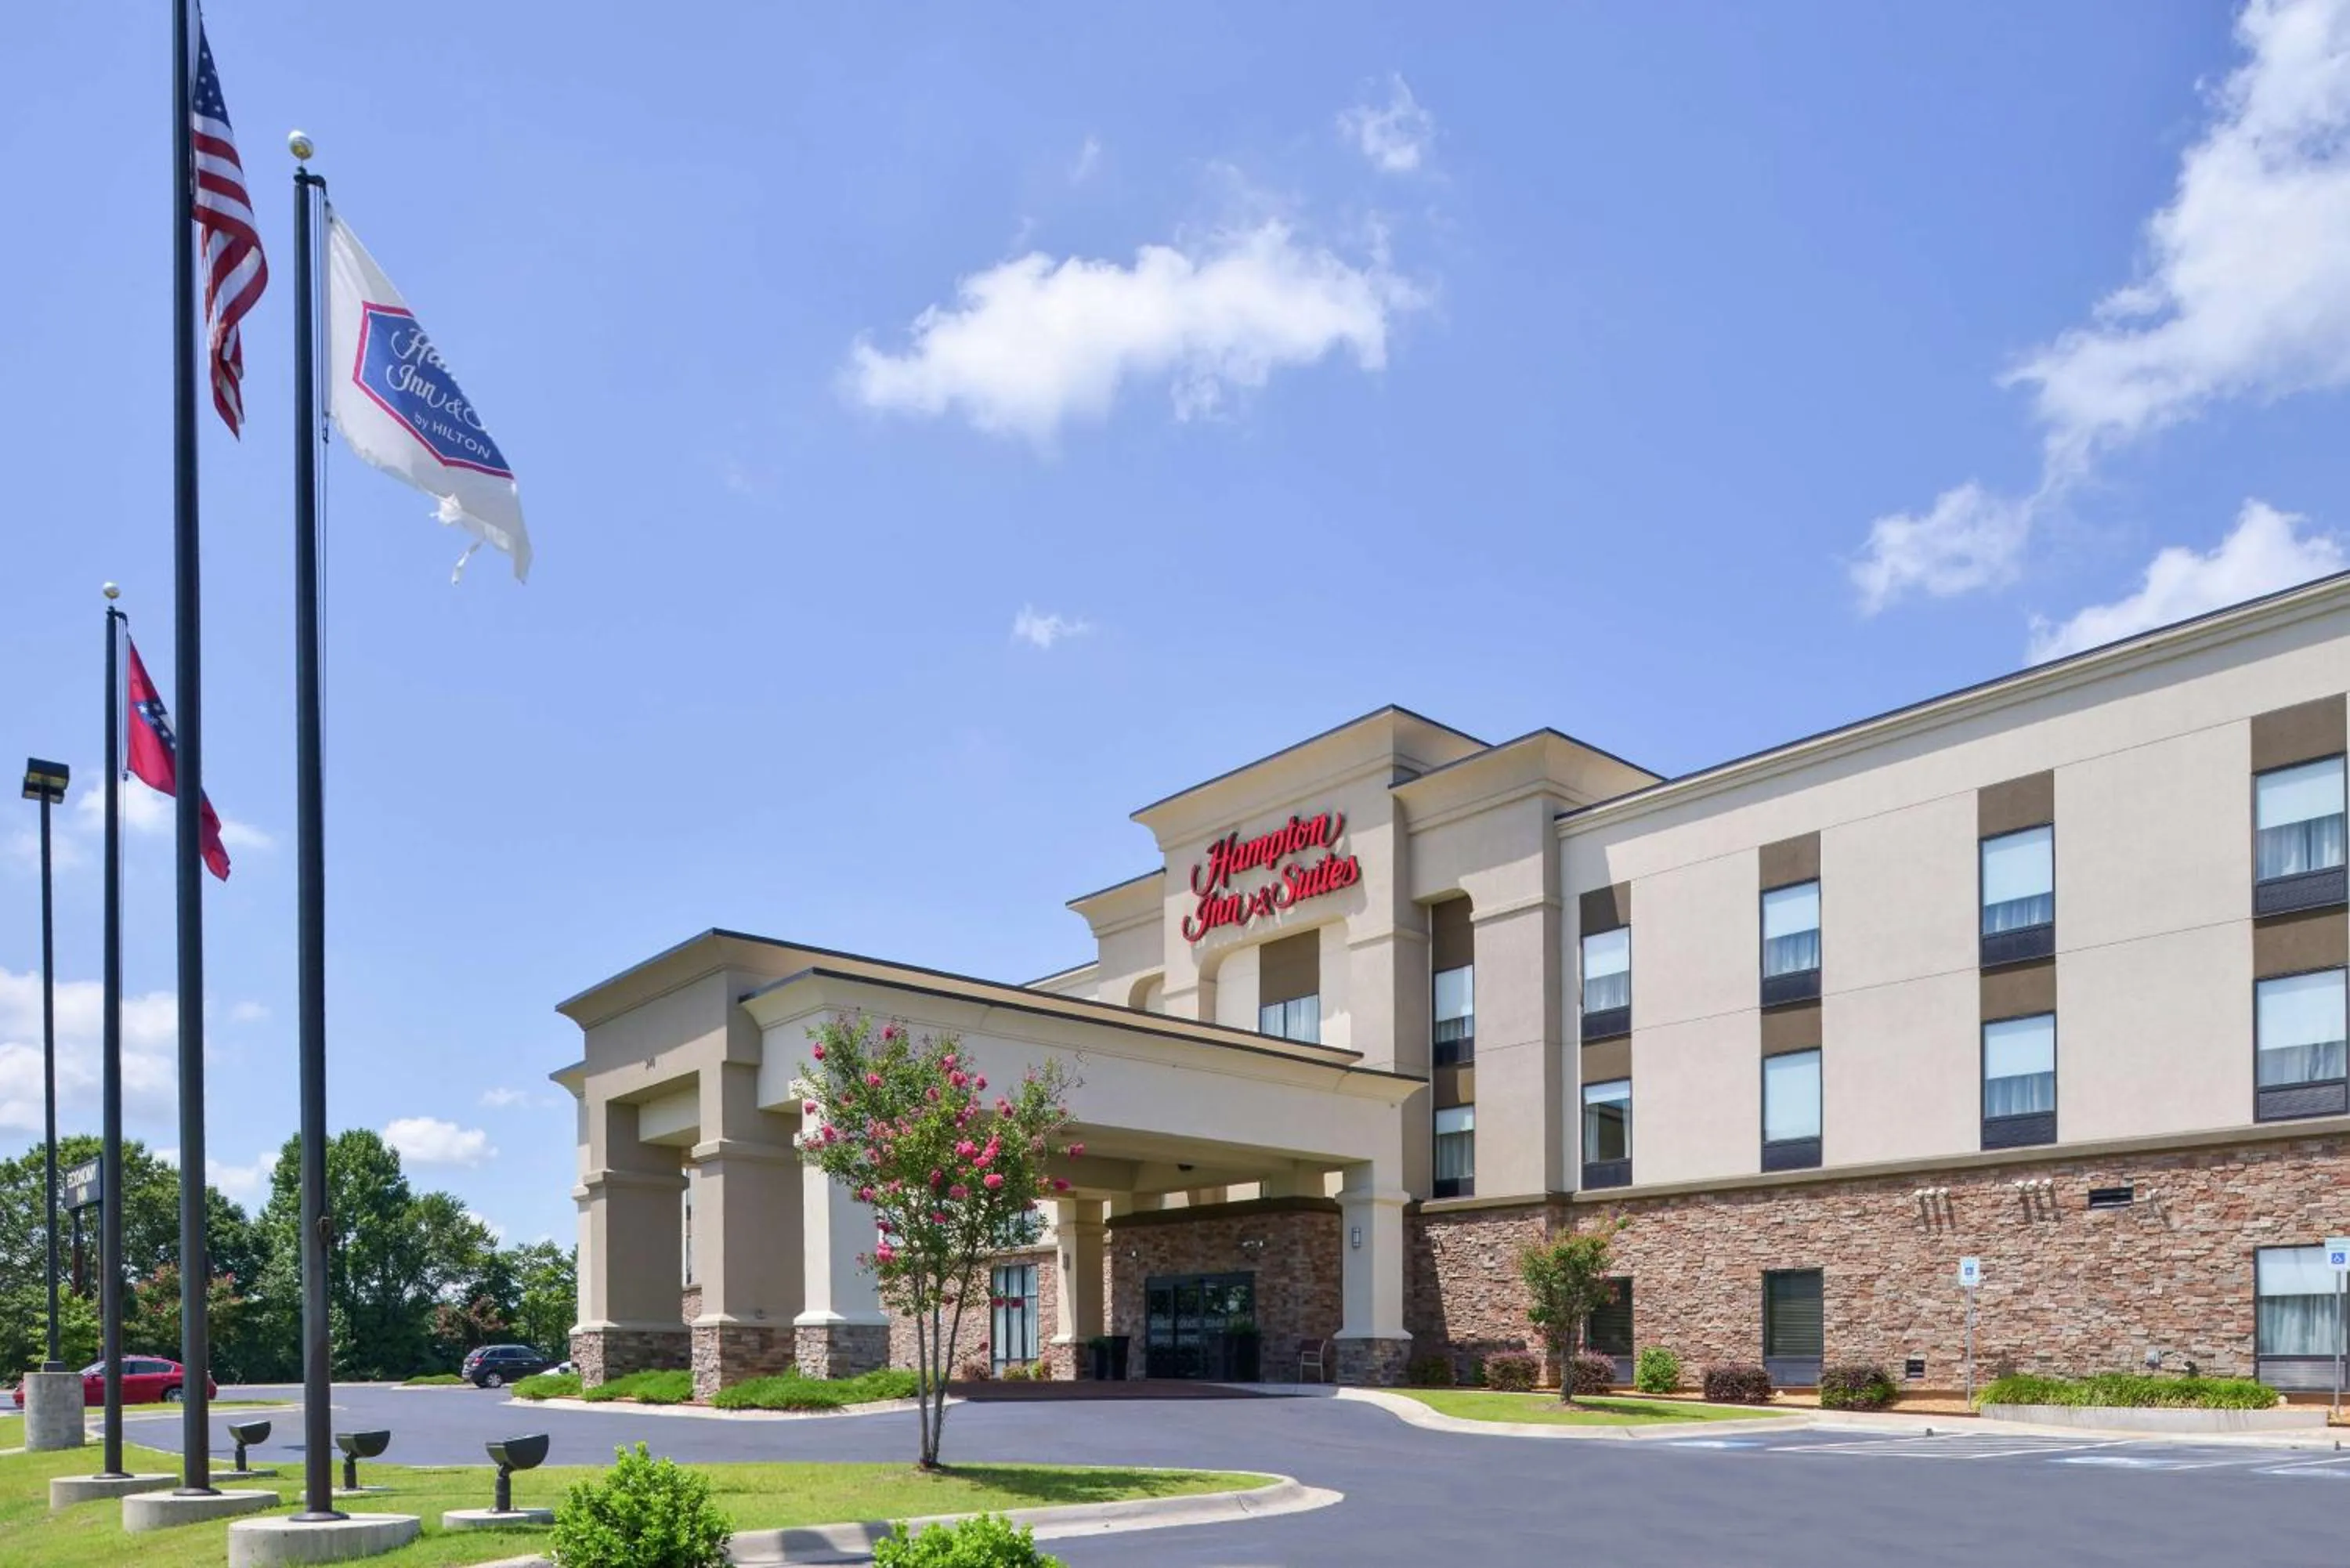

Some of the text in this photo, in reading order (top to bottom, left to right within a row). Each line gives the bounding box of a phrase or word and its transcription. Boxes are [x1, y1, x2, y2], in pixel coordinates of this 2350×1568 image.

[387, 364, 447, 408] Inn
[445, 399, 463, 423] &
[432, 419, 491, 461] HILTON
[1191, 812, 1344, 898] Hampton
[1181, 854, 1358, 942] Inn & Suites
